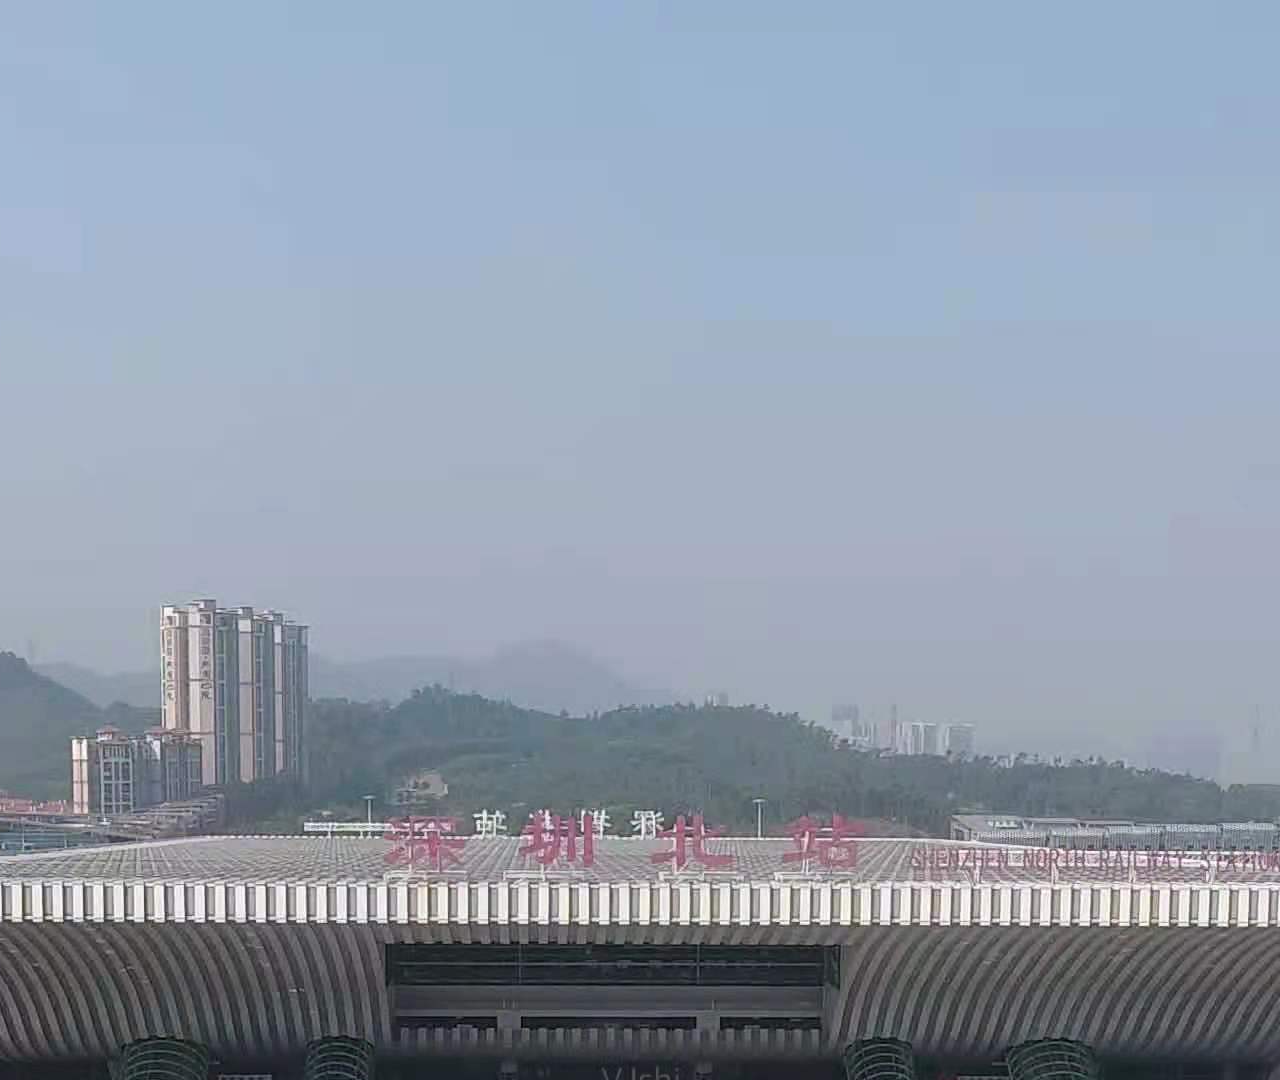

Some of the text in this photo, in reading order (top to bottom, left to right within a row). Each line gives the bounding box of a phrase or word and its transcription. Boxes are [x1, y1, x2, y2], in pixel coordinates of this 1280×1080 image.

[384, 812, 863, 868] 深圳北站
[912, 847, 1009, 869] SHENZHEN
[1023, 848, 1086, 871] NORTH
[1100, 849, 1185, 870] RAILWAY
